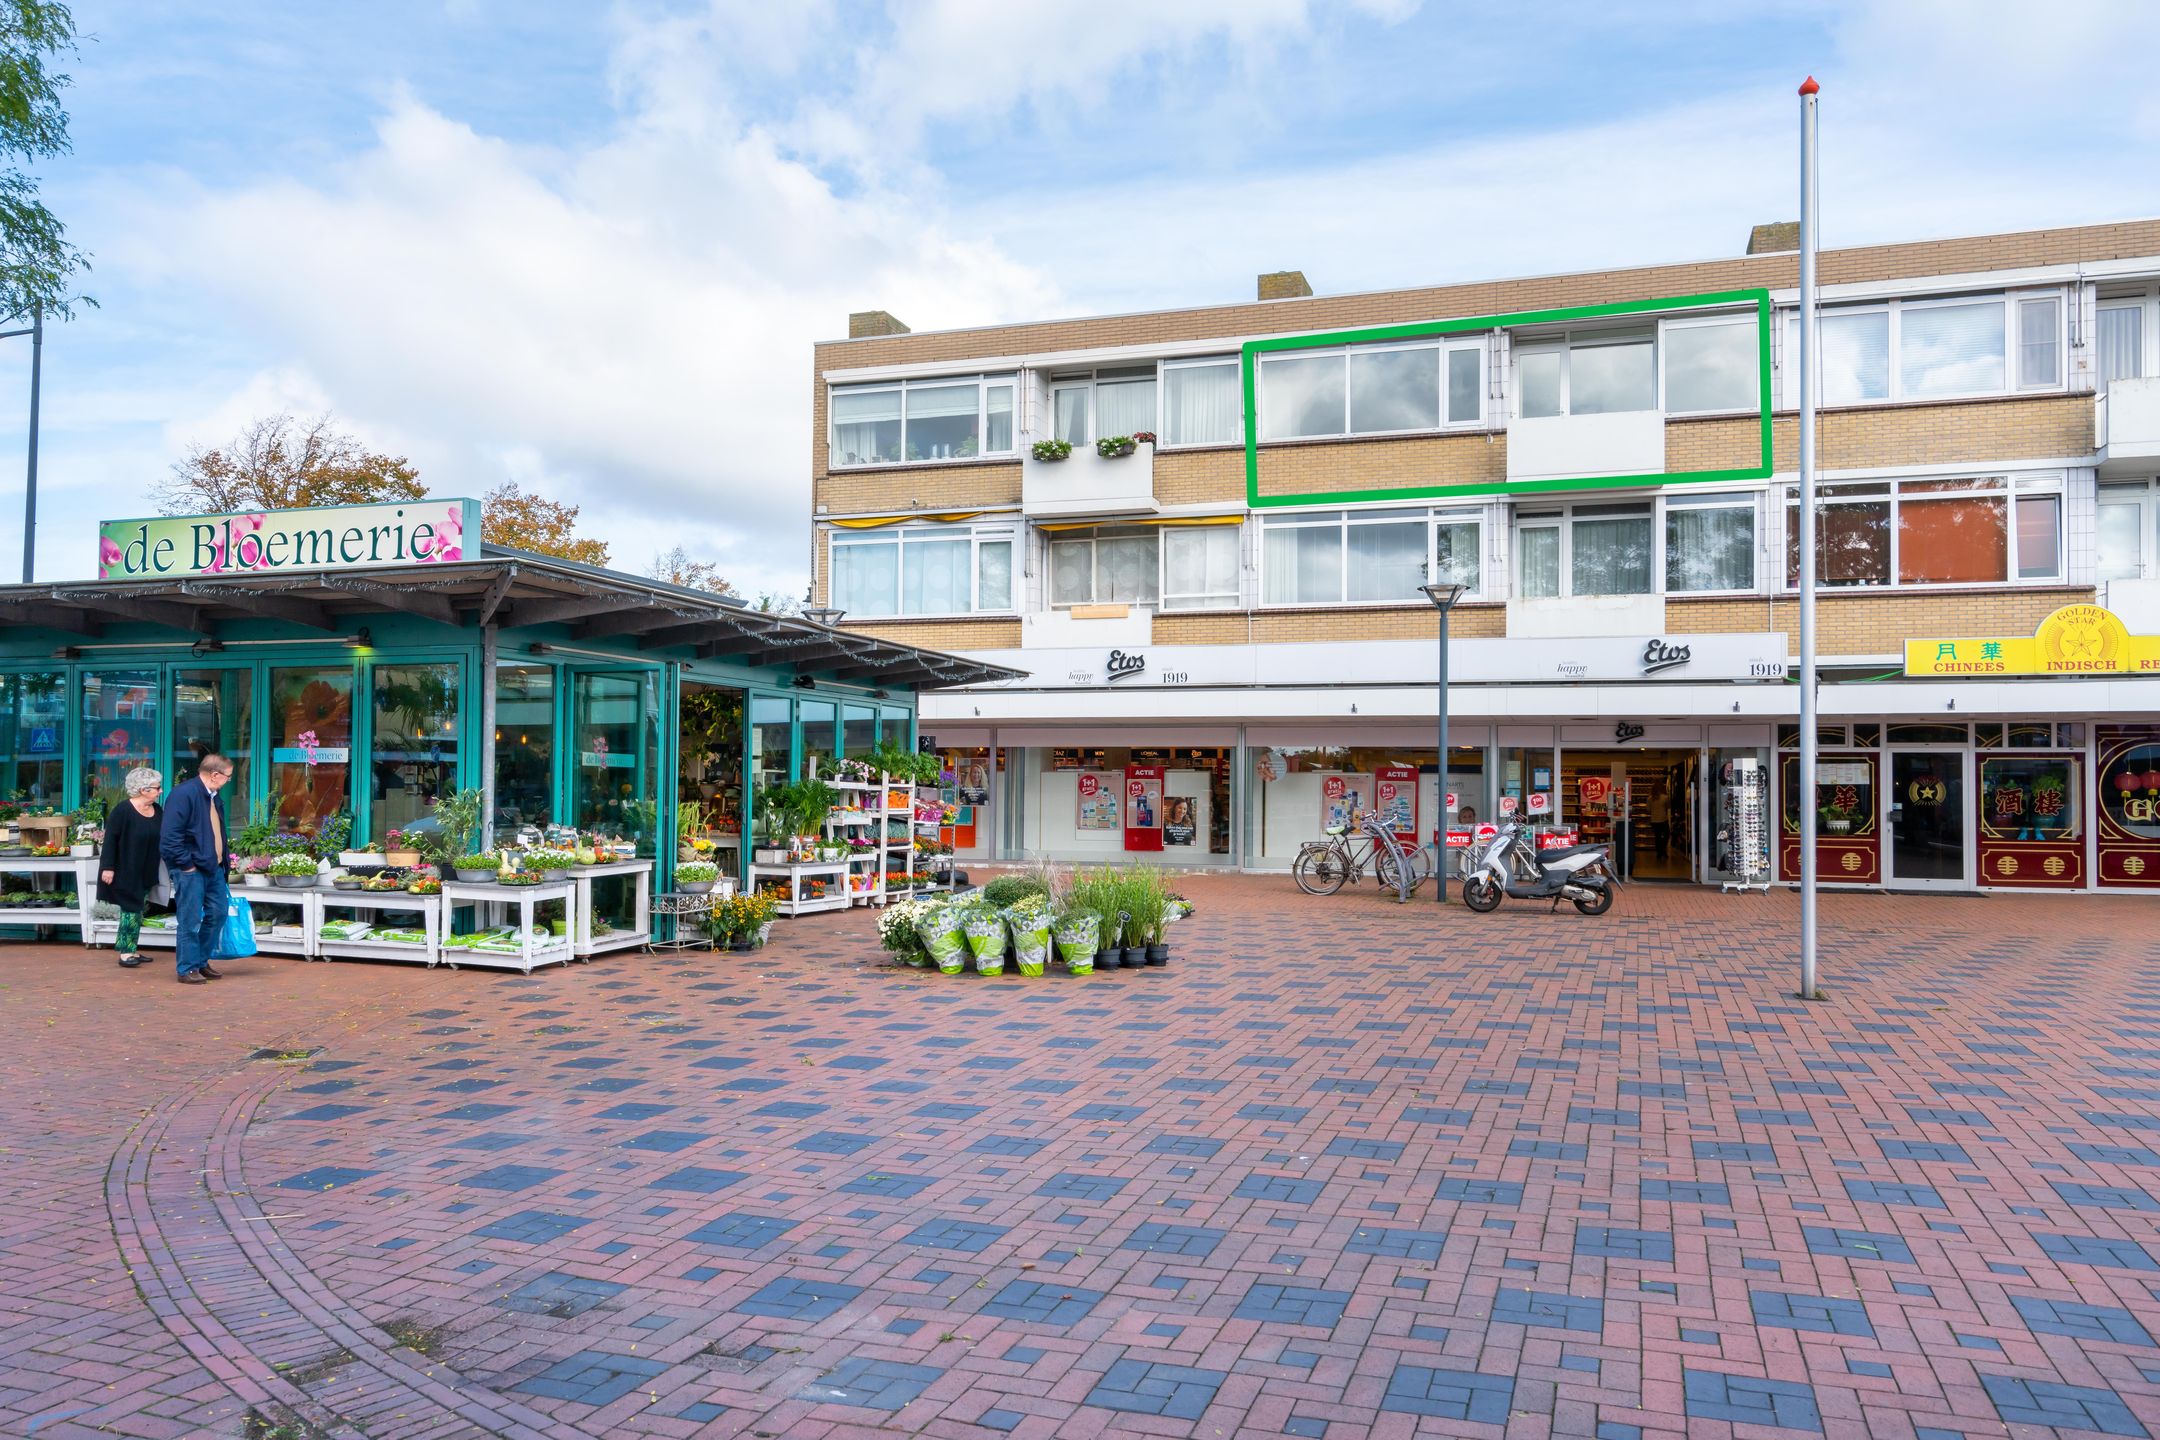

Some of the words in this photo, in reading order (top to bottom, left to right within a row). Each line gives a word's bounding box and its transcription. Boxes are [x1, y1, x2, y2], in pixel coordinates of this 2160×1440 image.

[123, 524, 175, 574] de
[190, 509, 436, 570] Bloemerie
[2056, 607, 2107, 621] GOLDEN
[2068, 616, 2096, 626] STAR
[1642, 638, 1691, 666] Etos
[1106, 649, 1146, 674] Etos
[1934, 662, 2005, 673] CHINEES
[2047, 660, 2117, 671] INDISCH
[1556, 663, 1588, 674] happy
[1750, 663, 1782, 676] 1919
[1163, 672, 1188, 683] 1919
[1615, 722, 1645, 739] Etos
[300, 750, 343, 760] Blemerie
[1082, 778, 1096, 787] 1+1
[1327, 780, 1342, 789] 1+1
[1586, 782, 1602, 791] 1+1
[1382, 785, 1394, 793] 1+1
[1446, 835, 1470, 843] ACTIE
